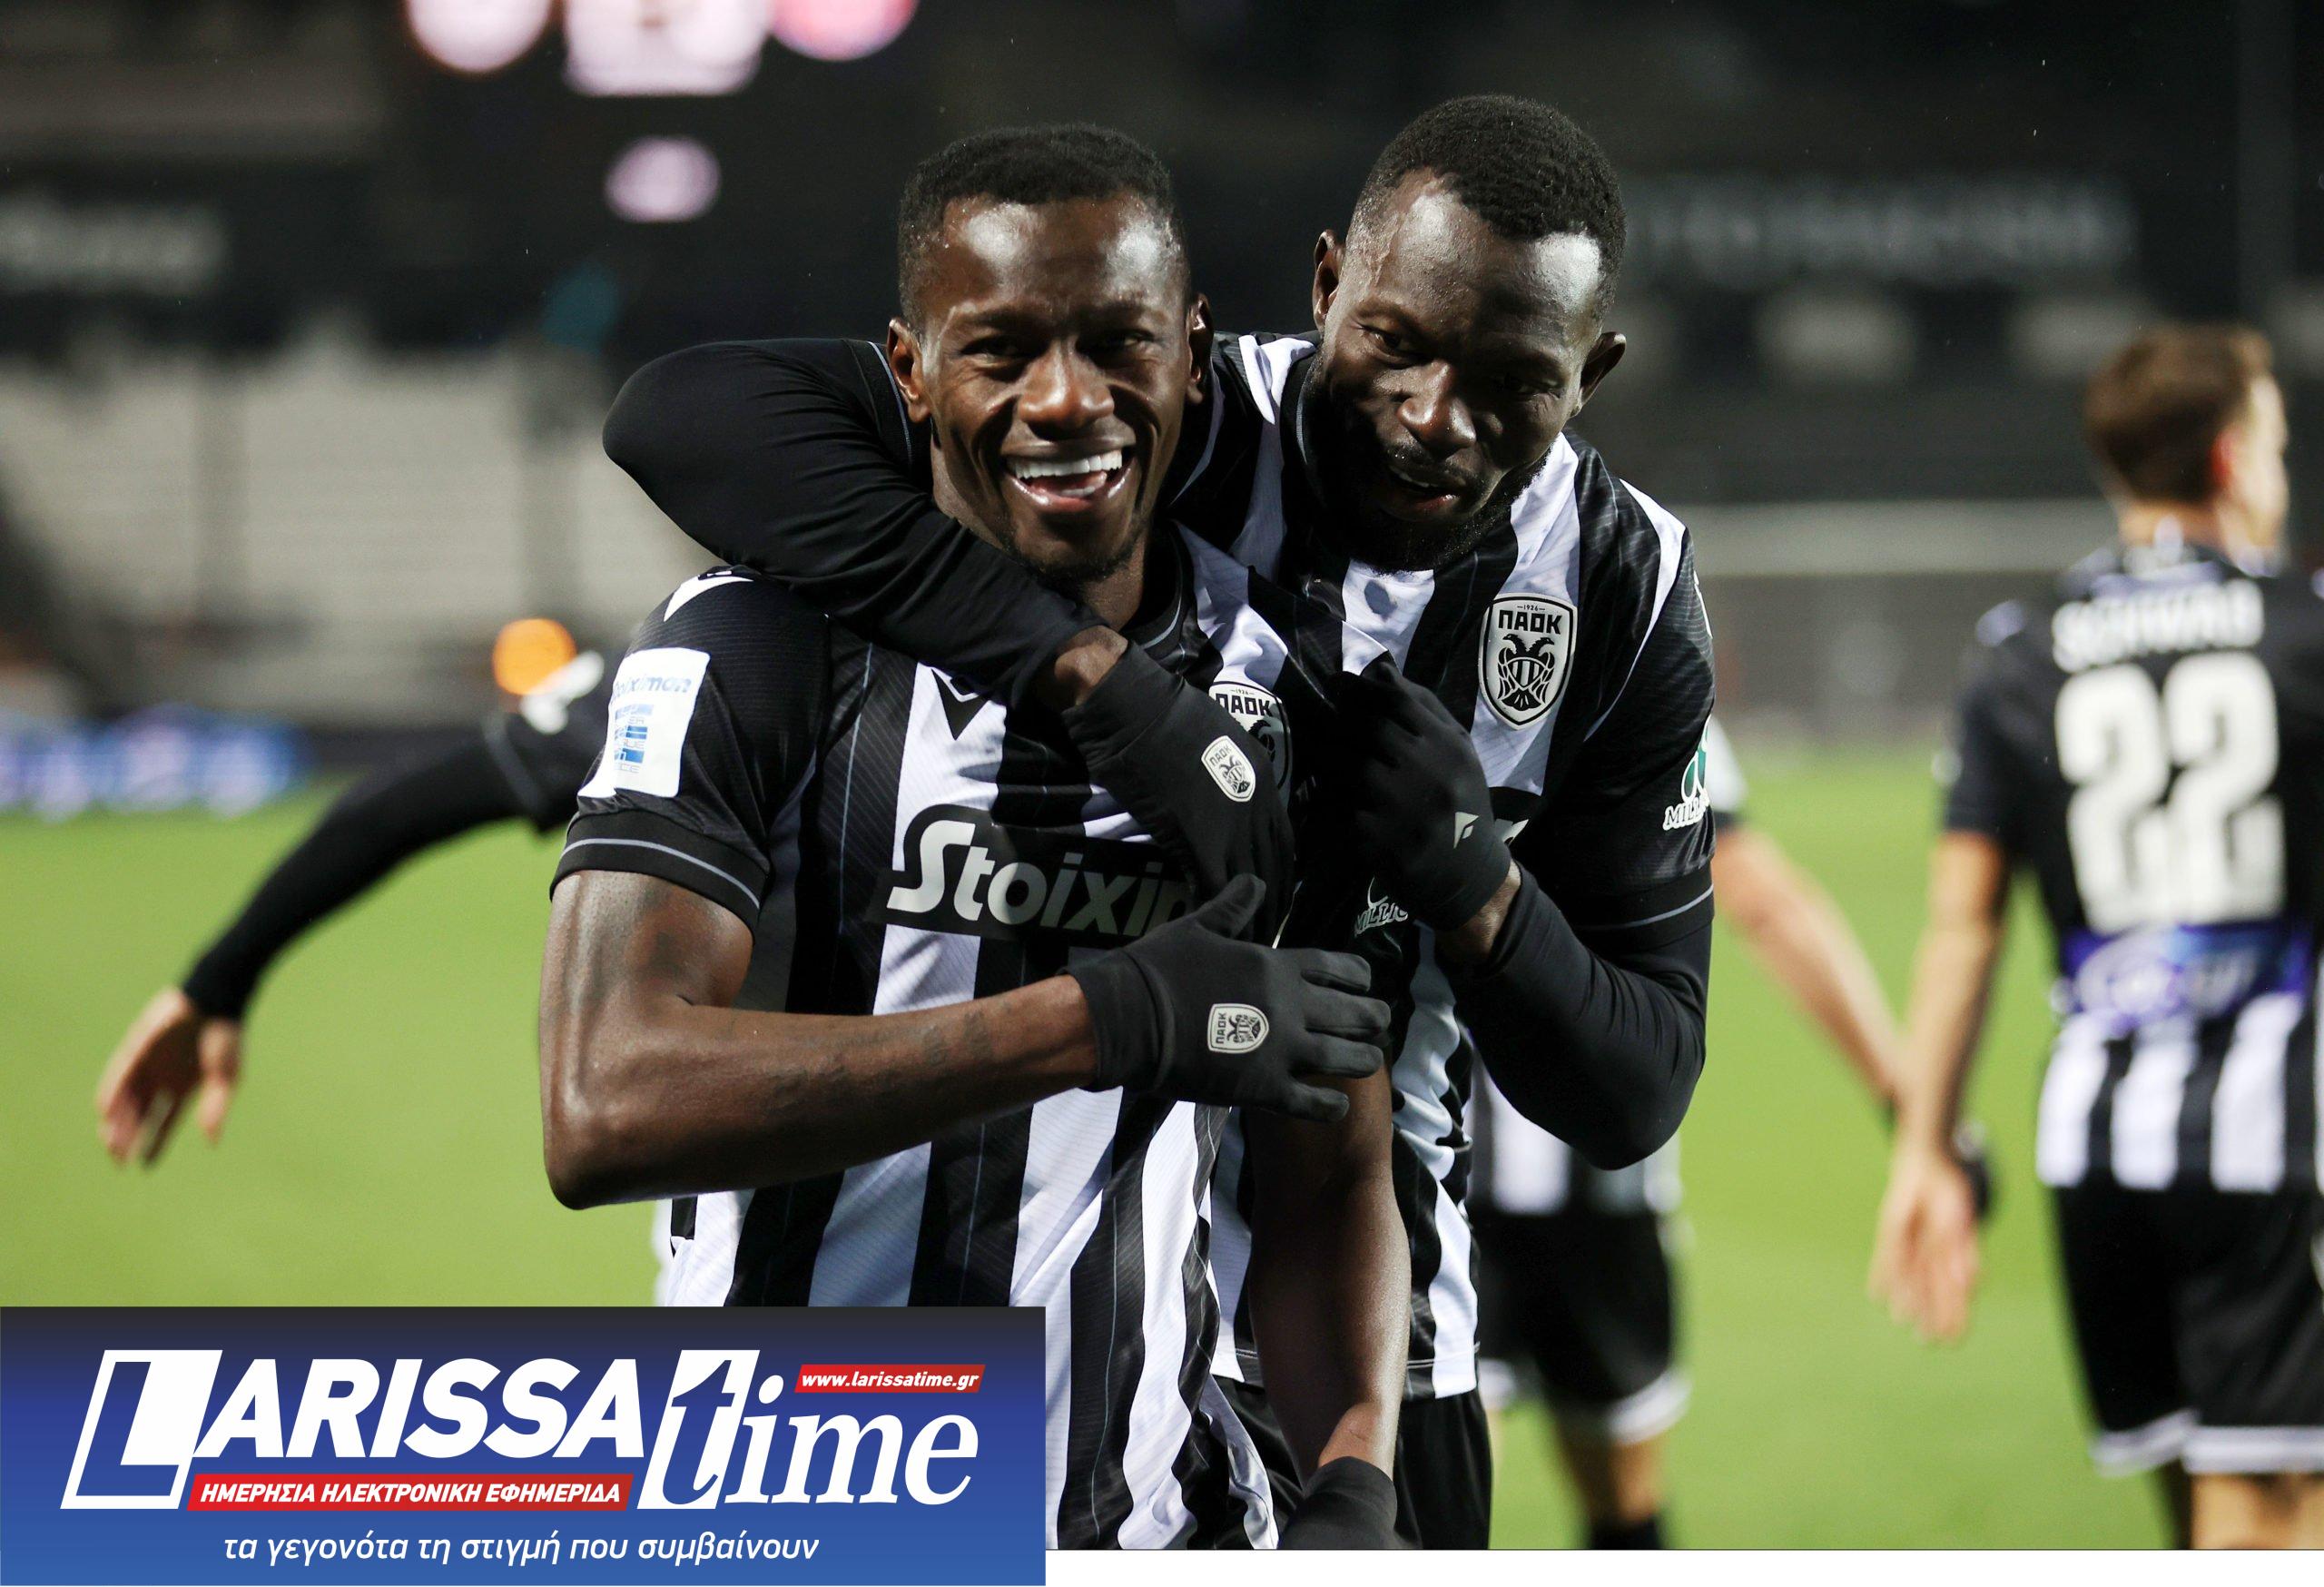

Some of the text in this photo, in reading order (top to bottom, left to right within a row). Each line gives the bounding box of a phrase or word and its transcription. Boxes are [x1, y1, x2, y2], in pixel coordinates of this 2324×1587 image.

[1499, 609, 1563, 635] ΠΑΟΚ
[1209, 746, 1232, 767] ΠΑΟΚ
[2053, 651, 2284, 933] 22
[1216, 1012, 1227, 1044] ΠΑΟΚ
